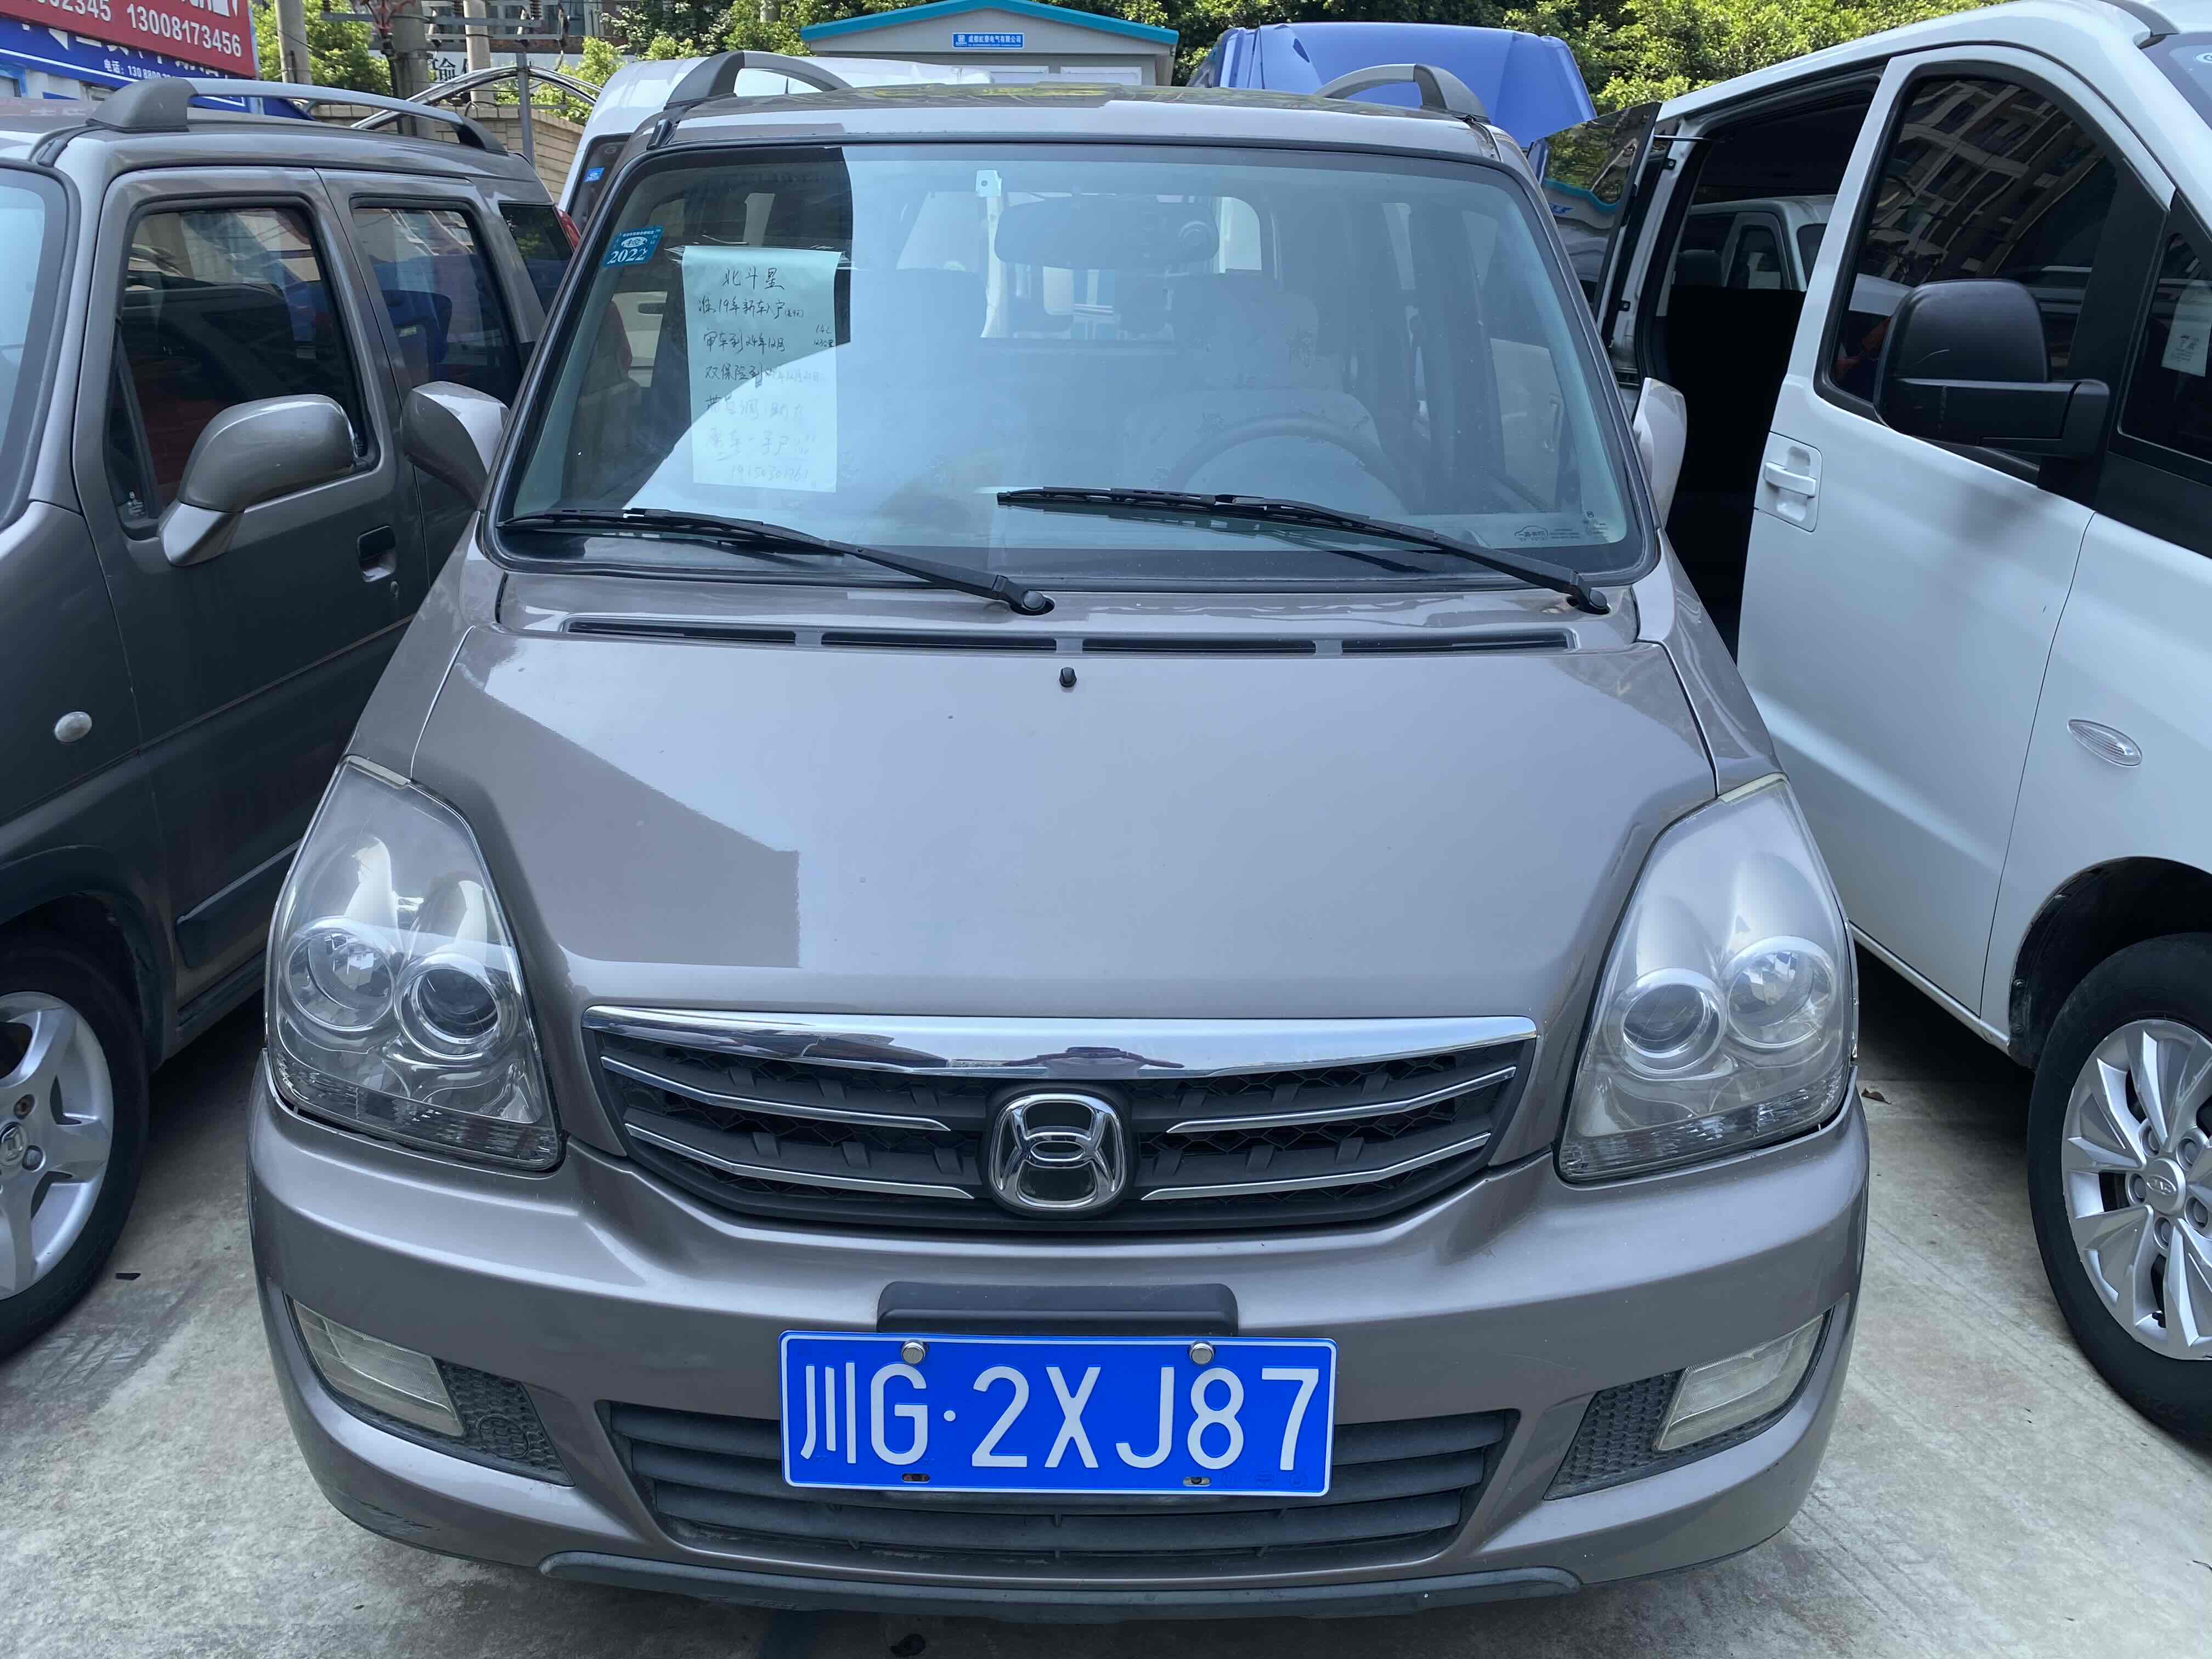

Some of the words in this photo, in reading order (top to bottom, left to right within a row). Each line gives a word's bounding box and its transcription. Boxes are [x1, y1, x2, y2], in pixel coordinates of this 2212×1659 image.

[127, 3, 241, 58] 13008173456
[606, 247, 648, 264] 2022
[721, 265, 786, 290] 北斗星
[800, 1361, 1319, 1472] 川G·2XJ87
